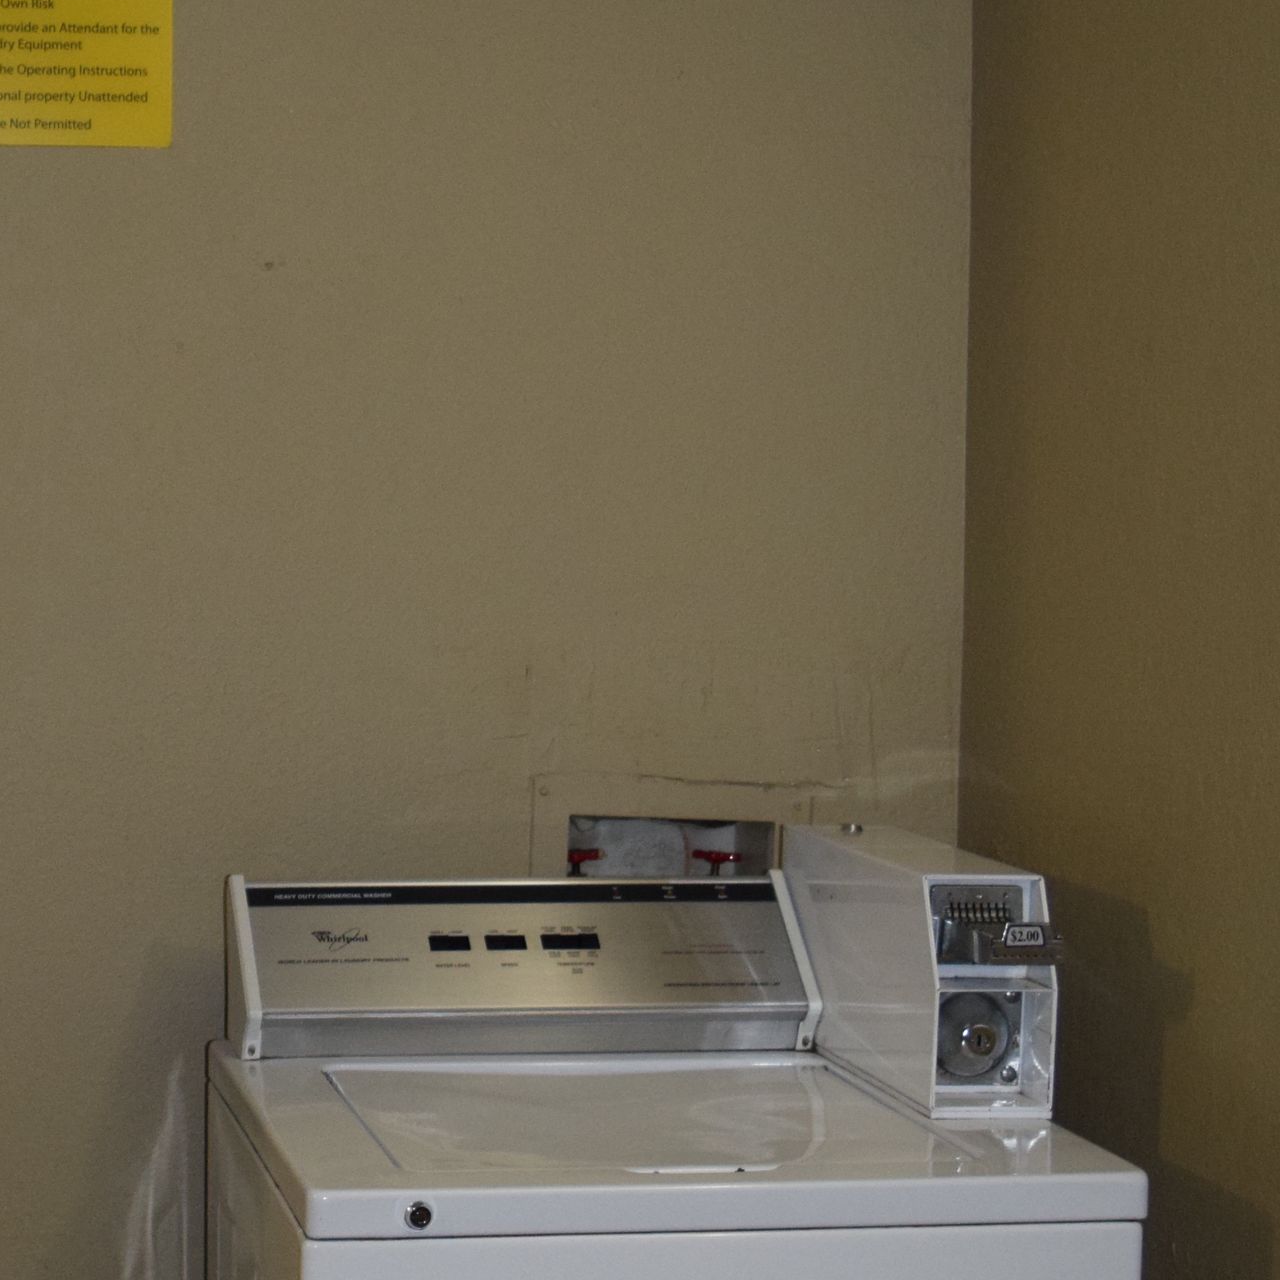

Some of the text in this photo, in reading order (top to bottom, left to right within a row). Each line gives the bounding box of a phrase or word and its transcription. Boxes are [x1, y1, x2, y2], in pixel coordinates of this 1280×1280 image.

[41, 25, 57, 33] an
[58, 22, 119, 34] Attendant
[120, 23, 138, 35] for
[139, 24, 160, 35] the
[17, 39, 83, 51] Equipment
[16, 65, 77, 78] Operating
[78, 66, 149, 77] Instructions
[23, 92, 76, 104] property
[78, 92, 149, 103] Unattended
[9, 118, 32, 129] Not
[33, 119, 93, 130] Permitted
[311, 930, 368, 945] Whirlpool
[1010, 929, 1039, 943] $2.00
